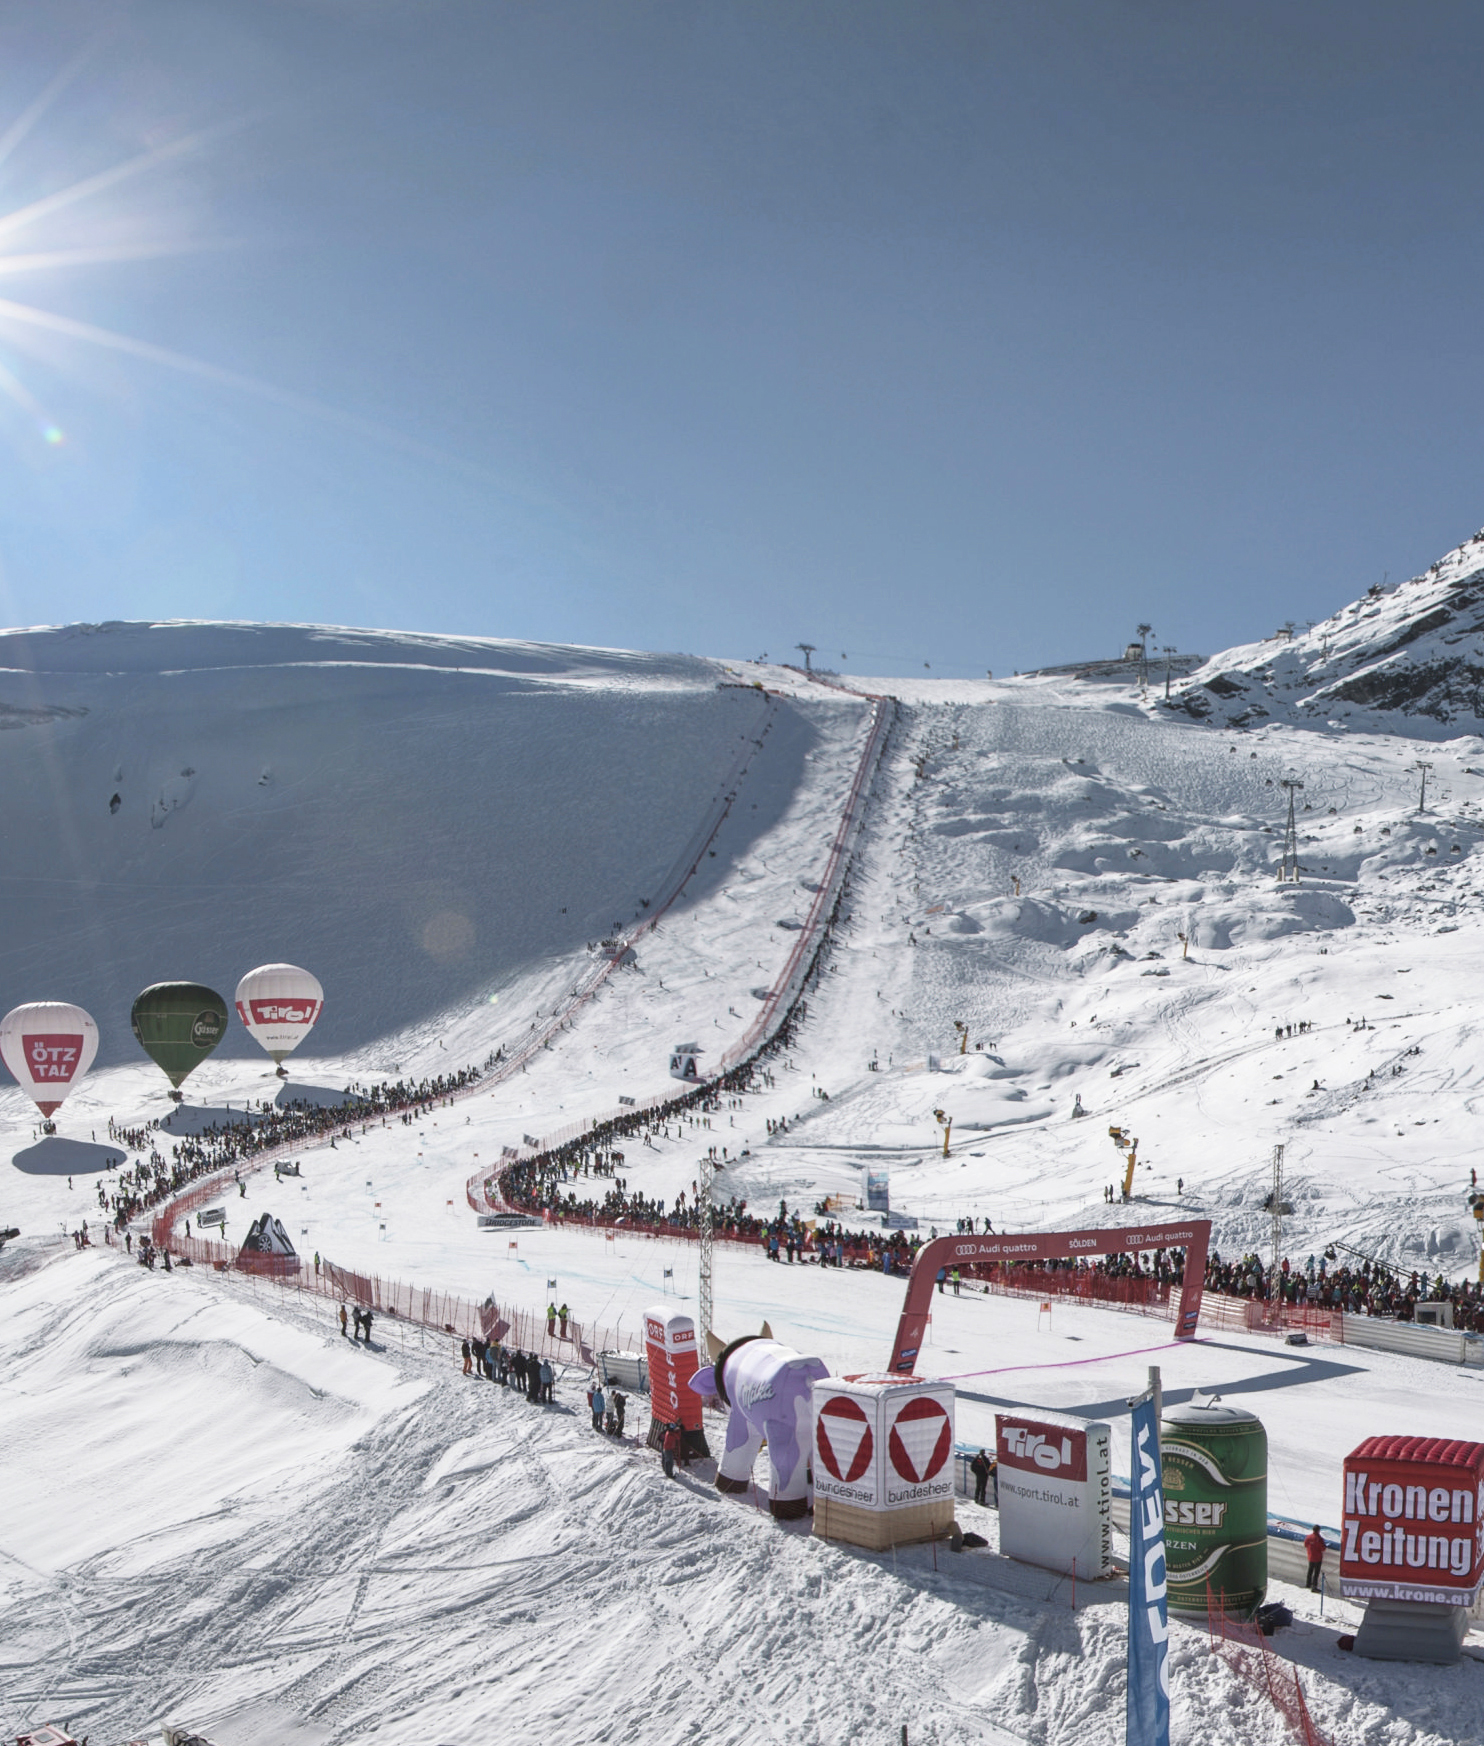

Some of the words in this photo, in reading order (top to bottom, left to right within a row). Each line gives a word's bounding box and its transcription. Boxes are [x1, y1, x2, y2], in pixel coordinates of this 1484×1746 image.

[257, 1005, 312, 1021] Tirol
[32, 1041, 77, 1062] ÖTZ
[34, 1064, 69, 1077] TAL
[1069, 1237, 1097, 1249] SÖLDEN
[1145, 1233, 1163, 1243] Audi
[1164, 1231, 1193, 1241] quattro
[979, 1243, 1000, 1253] Audi
[1002, 1243, 1037, 1254] quattro
[649, 1323, 664, 1342] ORF
[674, 1330, 693, 1342] ORF
[1002, 1427, 1071, 1470] Tirol
[815, 1478, 874, 1503] bundesheer
[888, 1481, 953, 1503] bundesheer
[1000, 1480, 1080, 1508] www.sport.tirol.at
[1344, 1471, 1474, 1524] Kronen
[1097, 1436, 1110, 1569] www.tirol.at
[1163, 1499, 1227, 1527] sser
[1166, 1539, 1197, 1551] RZEN
[1342, 1519, 1473, 1577] Zeitung
[1342, 1583, 1471, 1607] www.krone.at
